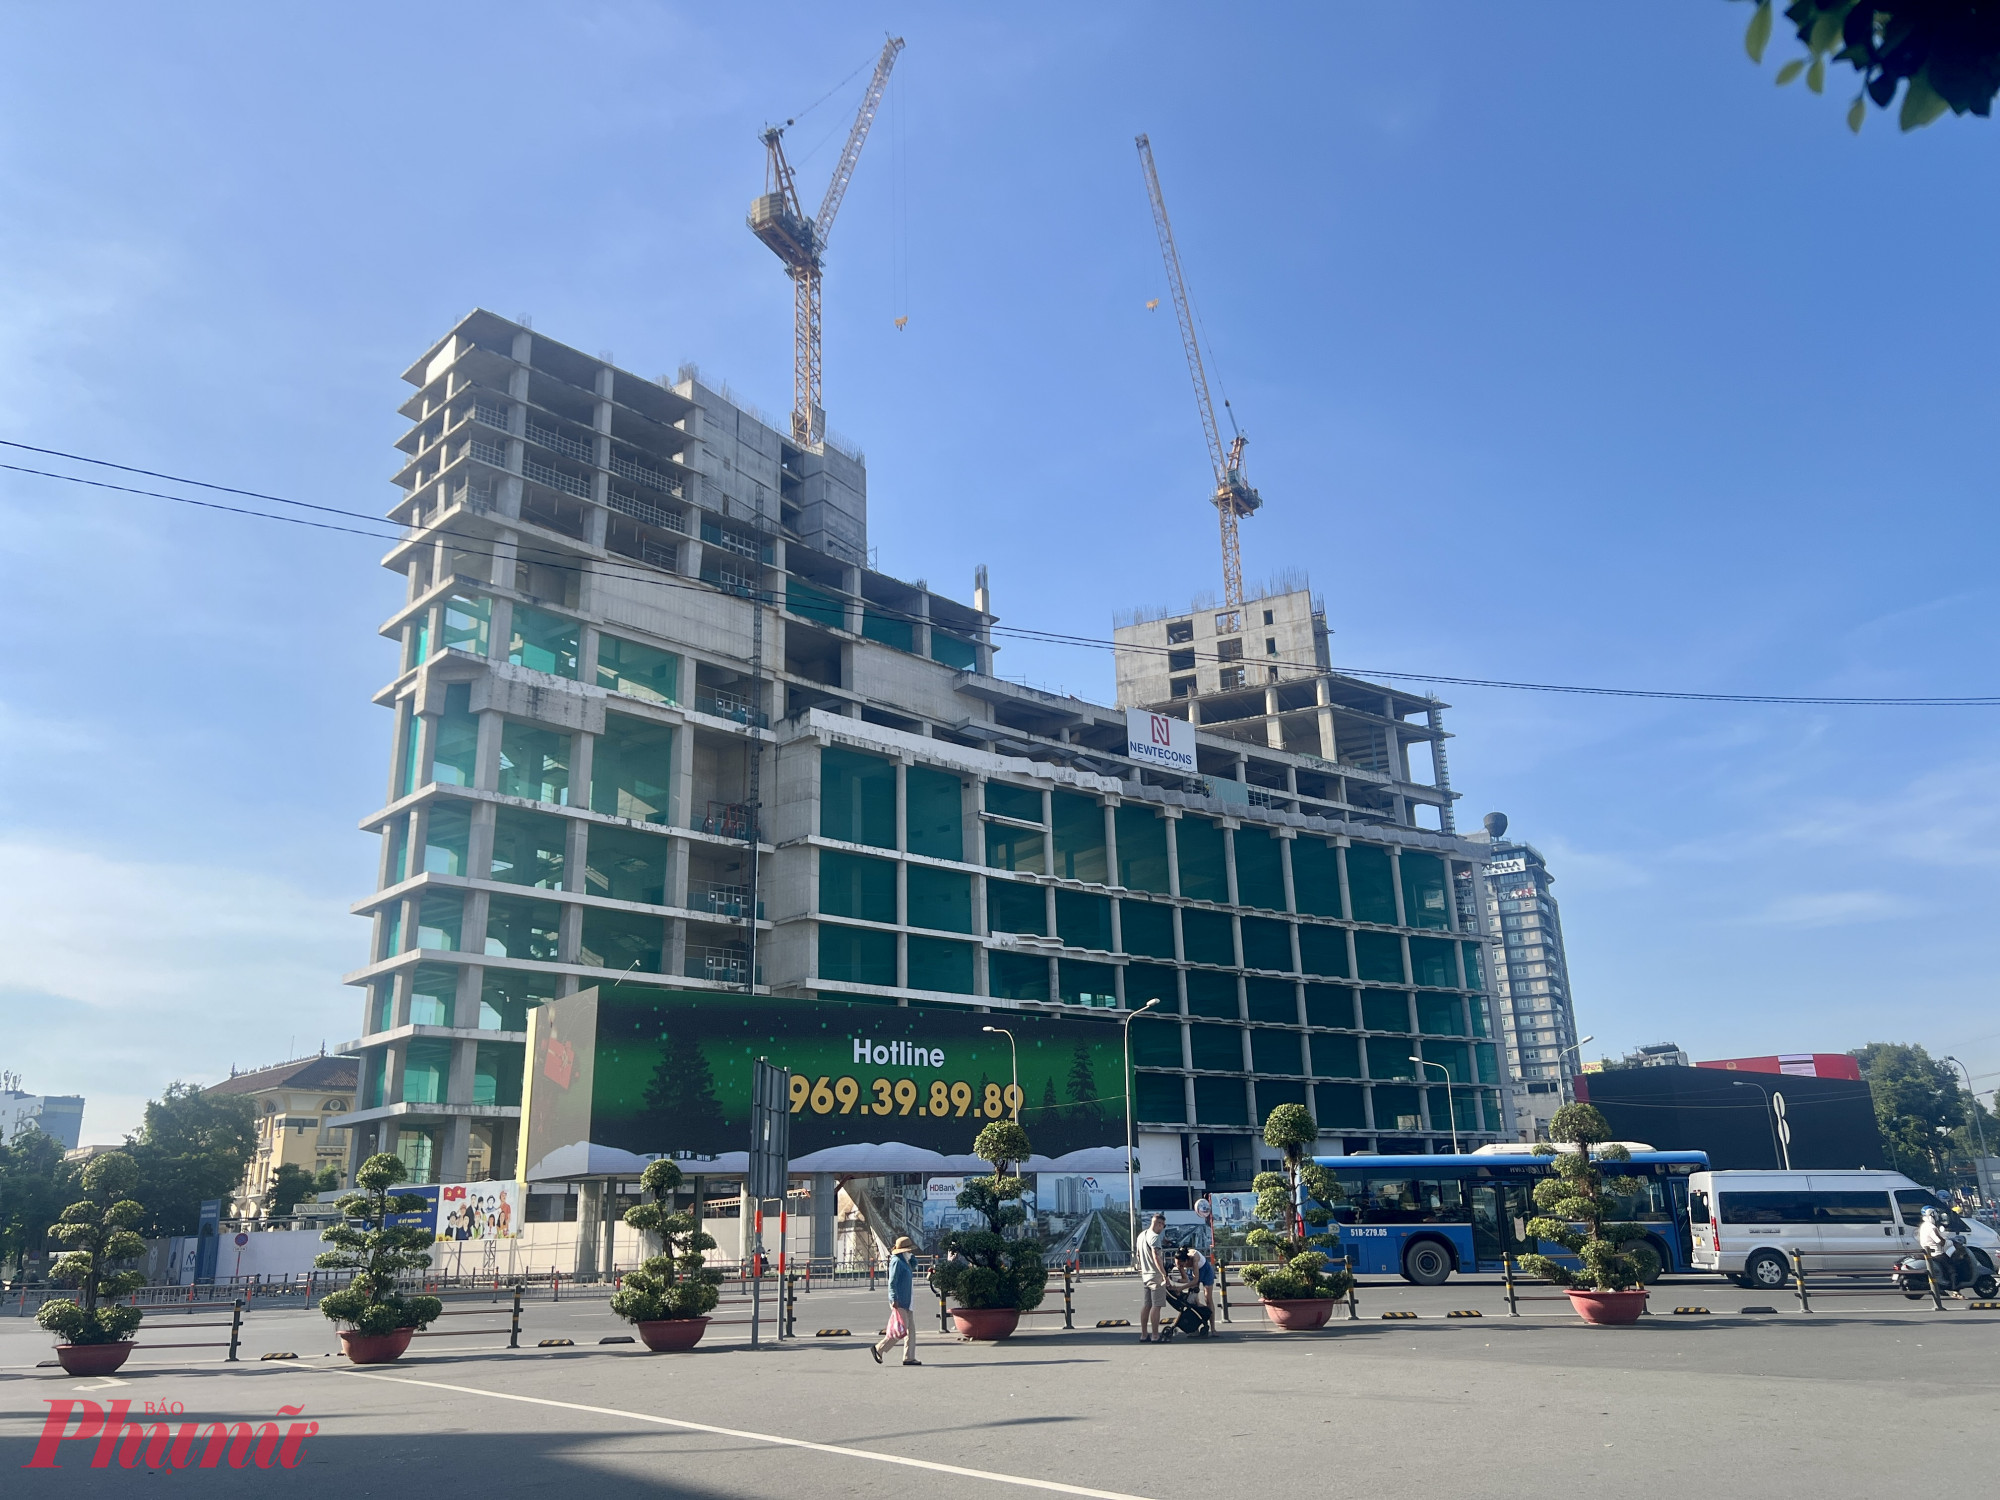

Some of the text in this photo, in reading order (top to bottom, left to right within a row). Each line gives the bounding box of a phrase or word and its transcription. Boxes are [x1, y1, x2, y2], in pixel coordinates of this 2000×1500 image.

[1130, 741, 1192, 765] NEWTECONS
[1481, 860, 1520, 871] APELLA
[853, 1038, 945, 1068] Hotline
[789, 1074, 1024, 1119] 969.39.89.89
[930, 1184, 956, 1192] HDBank
[1350, 1228, 1388, 1237] 51B-279.05
